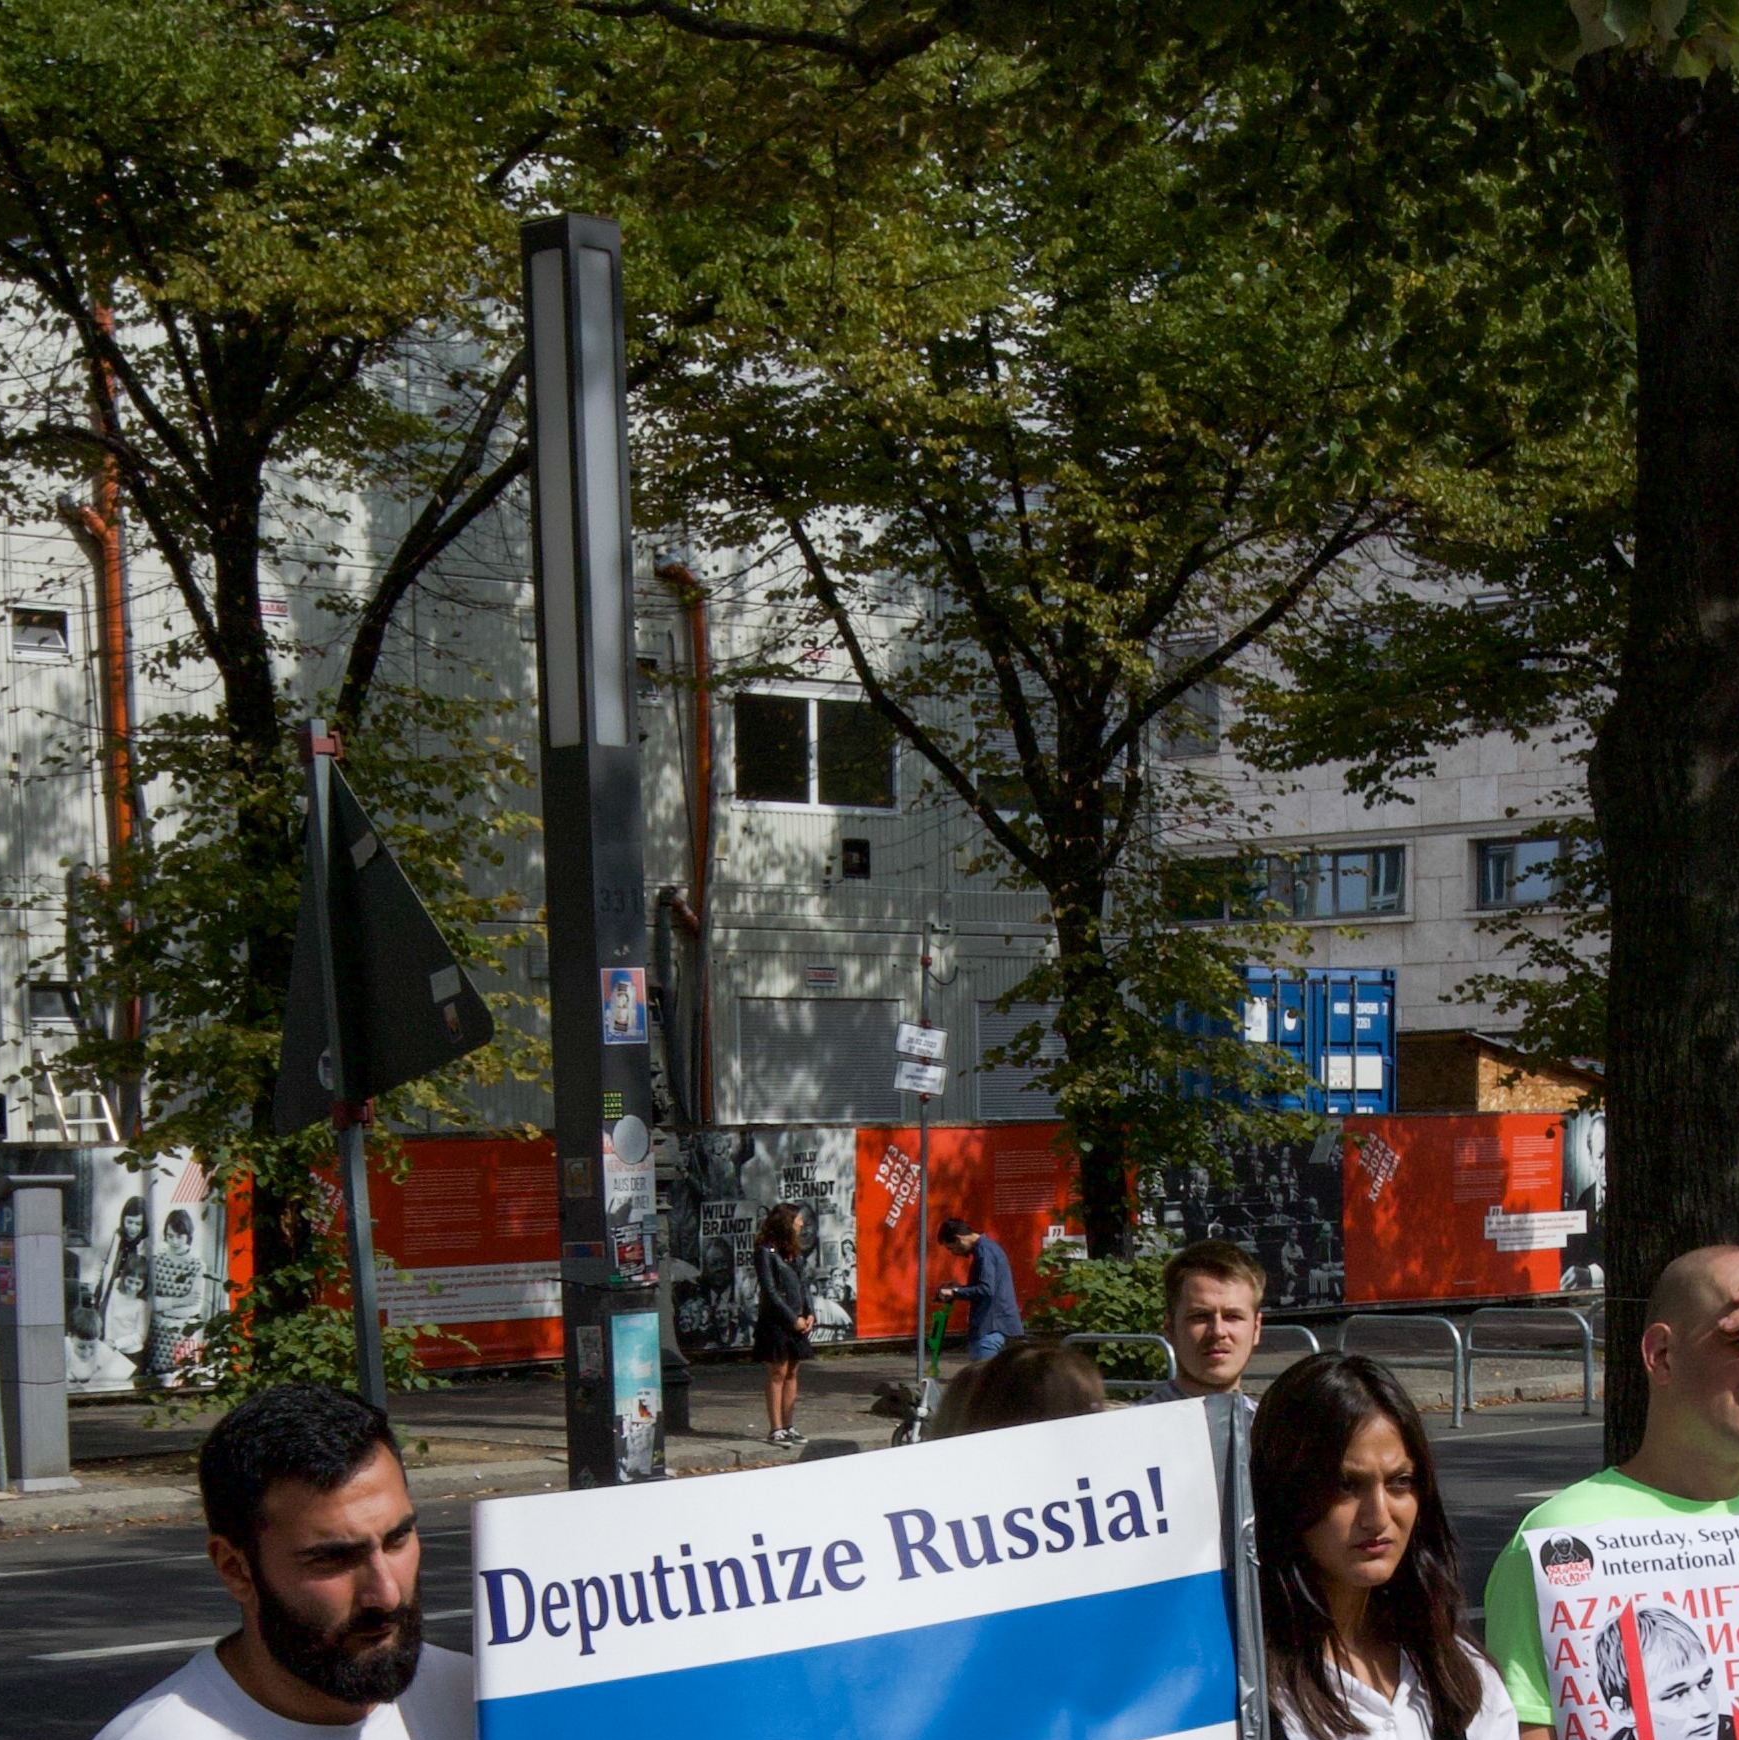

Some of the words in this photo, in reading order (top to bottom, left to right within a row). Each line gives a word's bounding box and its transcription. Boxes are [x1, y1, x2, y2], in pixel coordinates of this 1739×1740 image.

[874, 1144, 900, 1184] 1973
[1366, 1140, 1386, 1178] 2024
[630, 1177, 647, 1191] DER
[782, 1166, 817, 1183] WILLY
[885, 1152, 910, 1195] 2023
[1368, 1147, 1395, 1202] KRISEN
[784, 1181, 835, 1199] BRANDT
[885, 1163, 921, 1229] EUROPA
[702, 1203, 737, 1220] WILLY
[702, 1217, 753, 1236] BRANDT
[1596, 1529, 1693, 1551] Saturday,
[479, 1533, 869, 1656] Deputinize
[884, 1466, 1171, 1582] Russia!
[1601, 1549, 1737, 1577] International
